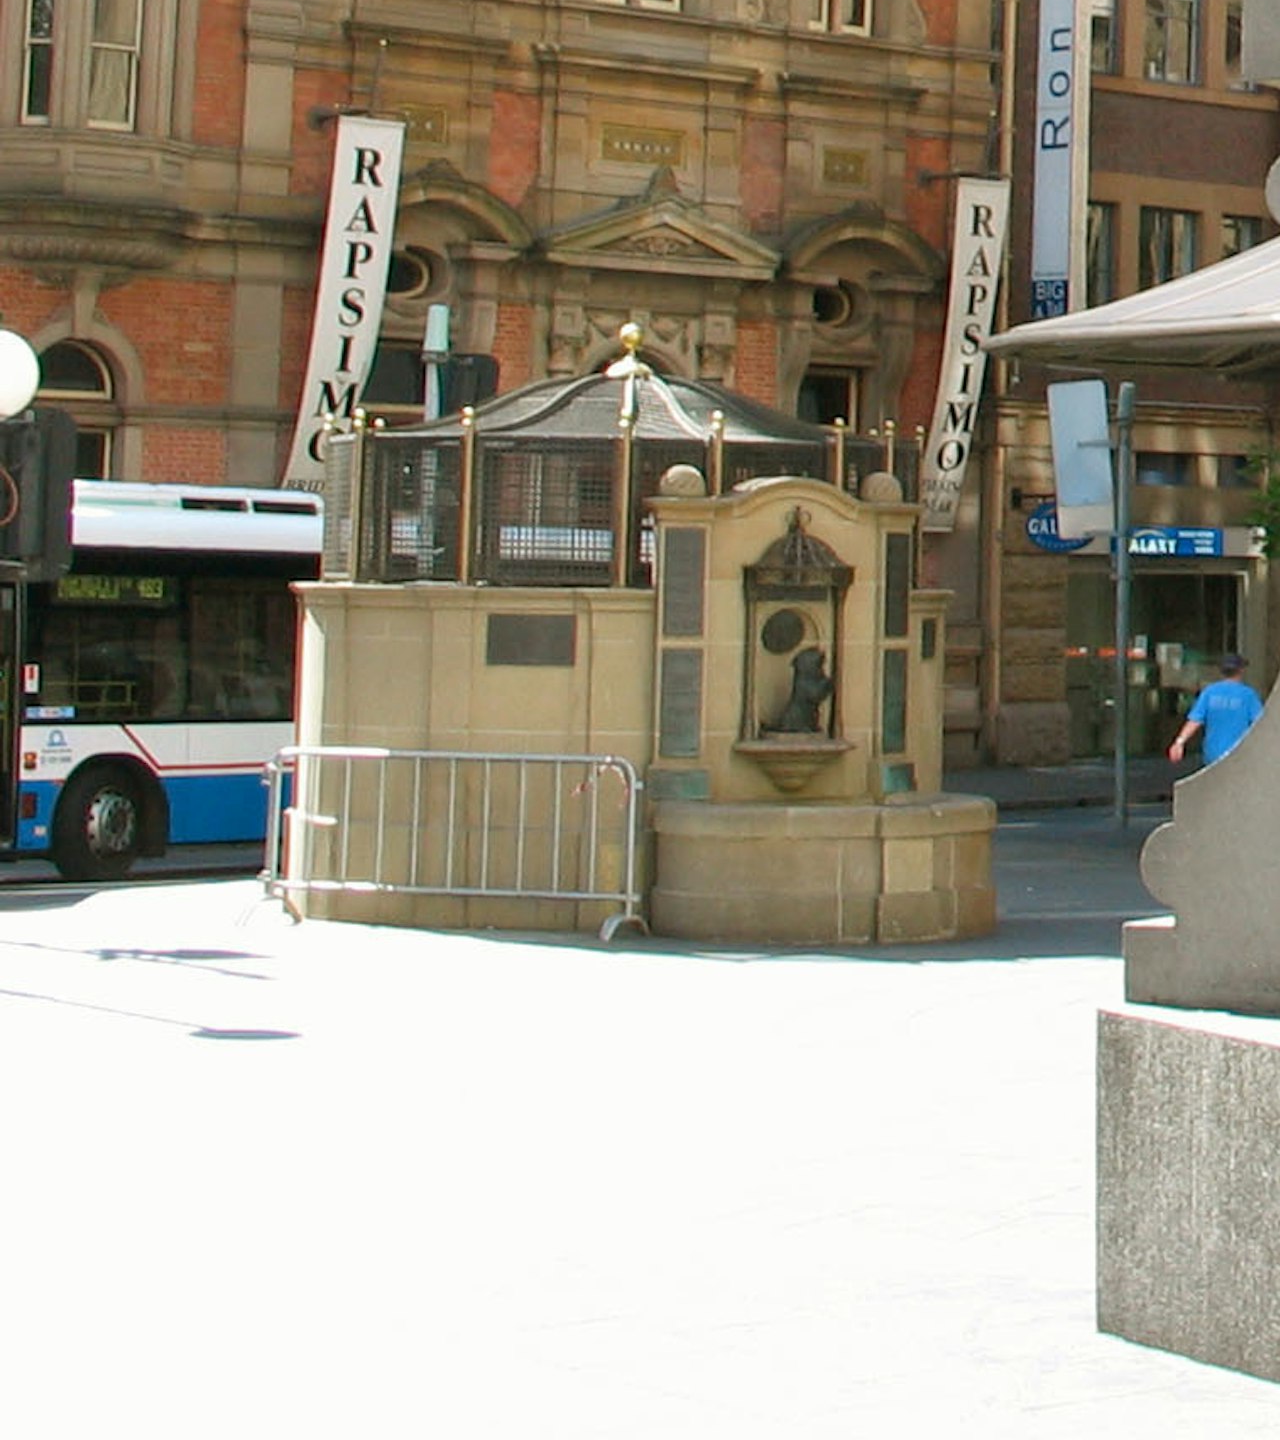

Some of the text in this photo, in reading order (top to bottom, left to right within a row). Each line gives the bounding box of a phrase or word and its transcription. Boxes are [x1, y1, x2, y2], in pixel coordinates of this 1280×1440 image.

[1041, 27, 1071, 150] Ron
[1035, 281, 1065, 300] BIG
[937, 203, 994, 471] RAPSIMO
[1128, 538, 1178, 554] ALAXY
